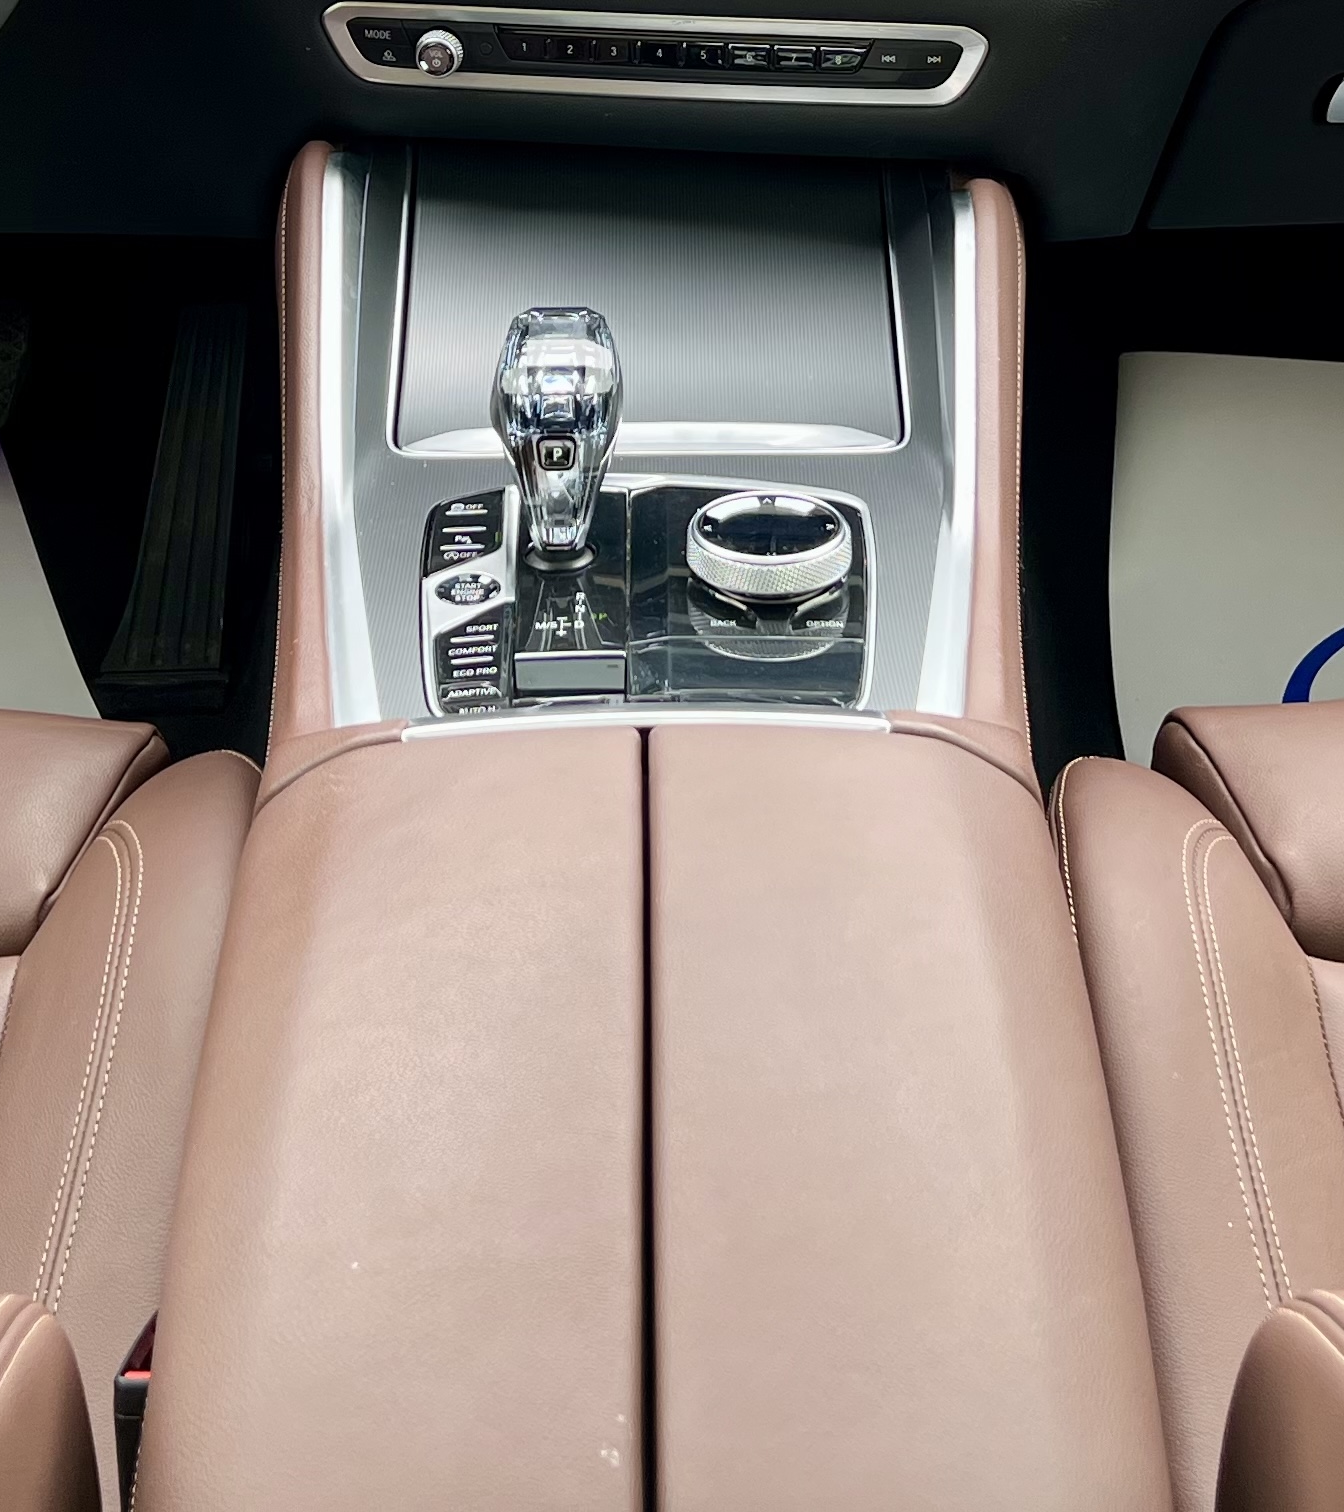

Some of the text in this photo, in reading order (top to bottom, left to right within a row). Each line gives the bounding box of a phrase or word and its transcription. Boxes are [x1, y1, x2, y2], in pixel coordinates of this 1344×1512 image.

[364, 28, 392, 40] MODE
[428, 50, 443, 58] VOL
[521, 42, 842, 65] 1 2 3 4 5 6 7 8
[552, 447, 563, 462] P
[465, 502, 484, 510] OFF
[459, 551, 479, 559] OFF
[450, 588, 485, 596] ENGINE
[455, 594, 481, 602] STOP
[466, 623, 499, 633] SPORT
[574, 619, 585, 629] D
[709, 619, 844, 628] BACK OPTION
[448, 644, 498, 656] COMFORT
[452, 666, 498, 678] ECO PRO
[447, 686, 498, 698] ADAPTIVE
